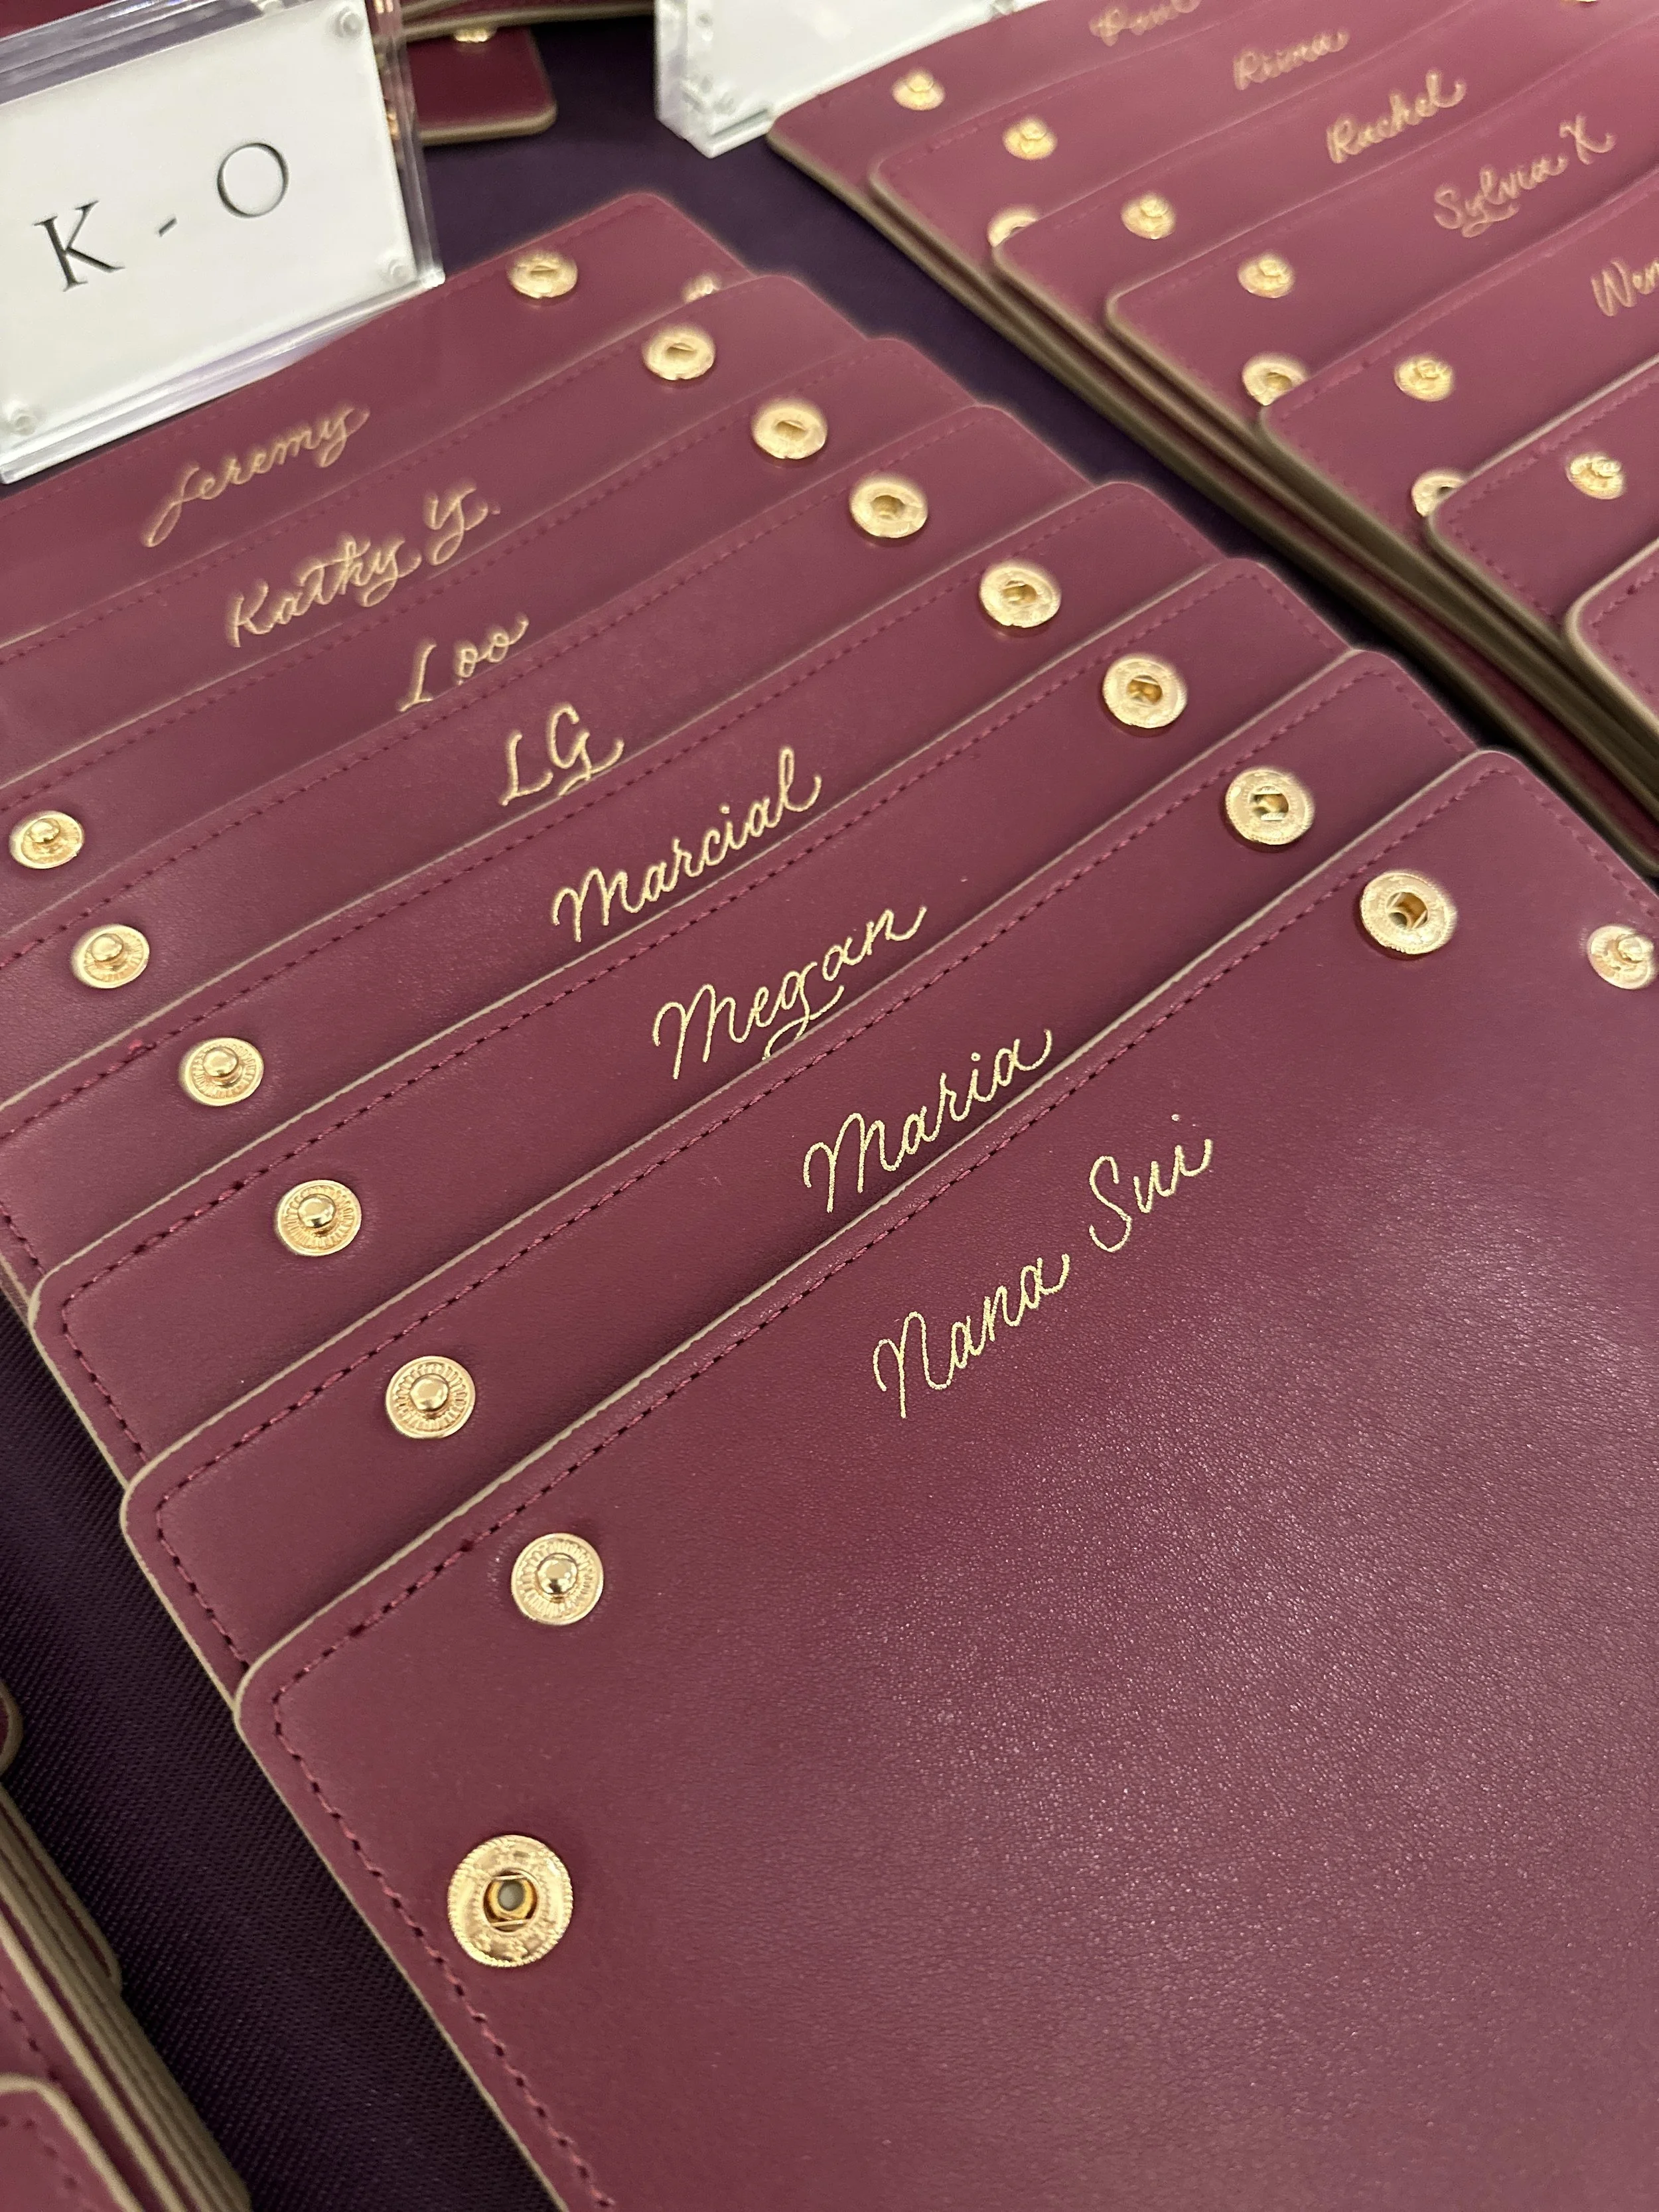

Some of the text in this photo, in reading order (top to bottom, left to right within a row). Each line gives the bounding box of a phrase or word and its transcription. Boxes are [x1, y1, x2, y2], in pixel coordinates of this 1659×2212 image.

[1327, 69, 1467, 164] Rachel
[33, 200, 126, 292] K
[216, 142, 289, 219] O
[141, 402, 371, 548] Jeremy
[226, 533, 423, 648] Kathy
[551, 746, 822, 943] Marcial
[652, 905, 928, 1080] Megan
[803, 1028, 1054, 1214] Maria
[872, 1113, 1214, 1419] Nana Sui
